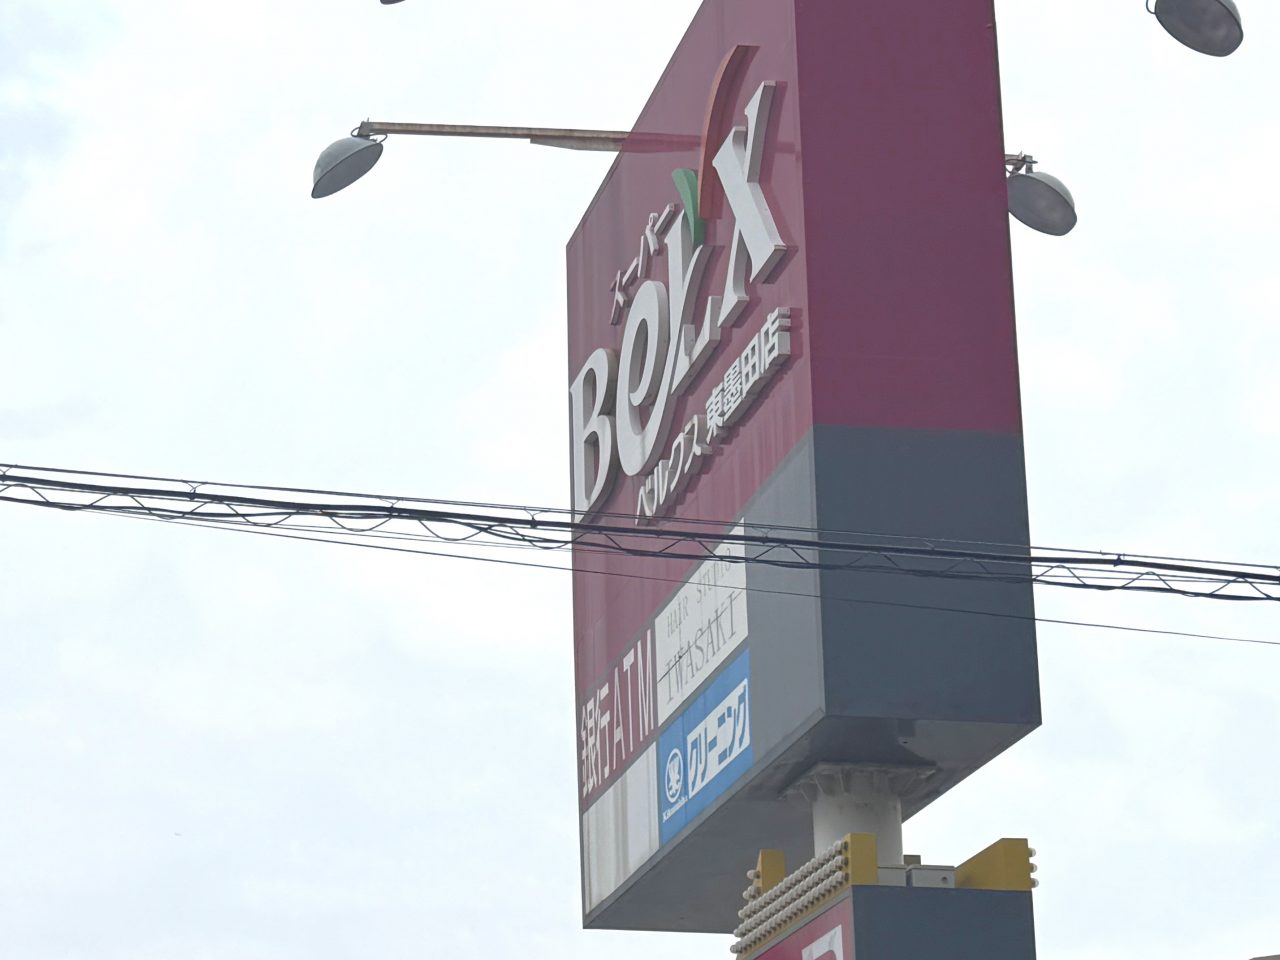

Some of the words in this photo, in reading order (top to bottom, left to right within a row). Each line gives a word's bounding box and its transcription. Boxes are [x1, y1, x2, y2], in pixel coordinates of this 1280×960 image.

[609, 203, 674, 325] スーパー
[635, 414, 705, 525] ベルクス
[706, 307, 791, 444] 東墨田店
[665, 591, 737, 704] IWASAKI
[666, 596, 689, 638] HAIR
[581, 629, 655, 798] 銀行ATM
[690, 688, 749, 793] クリーニング
